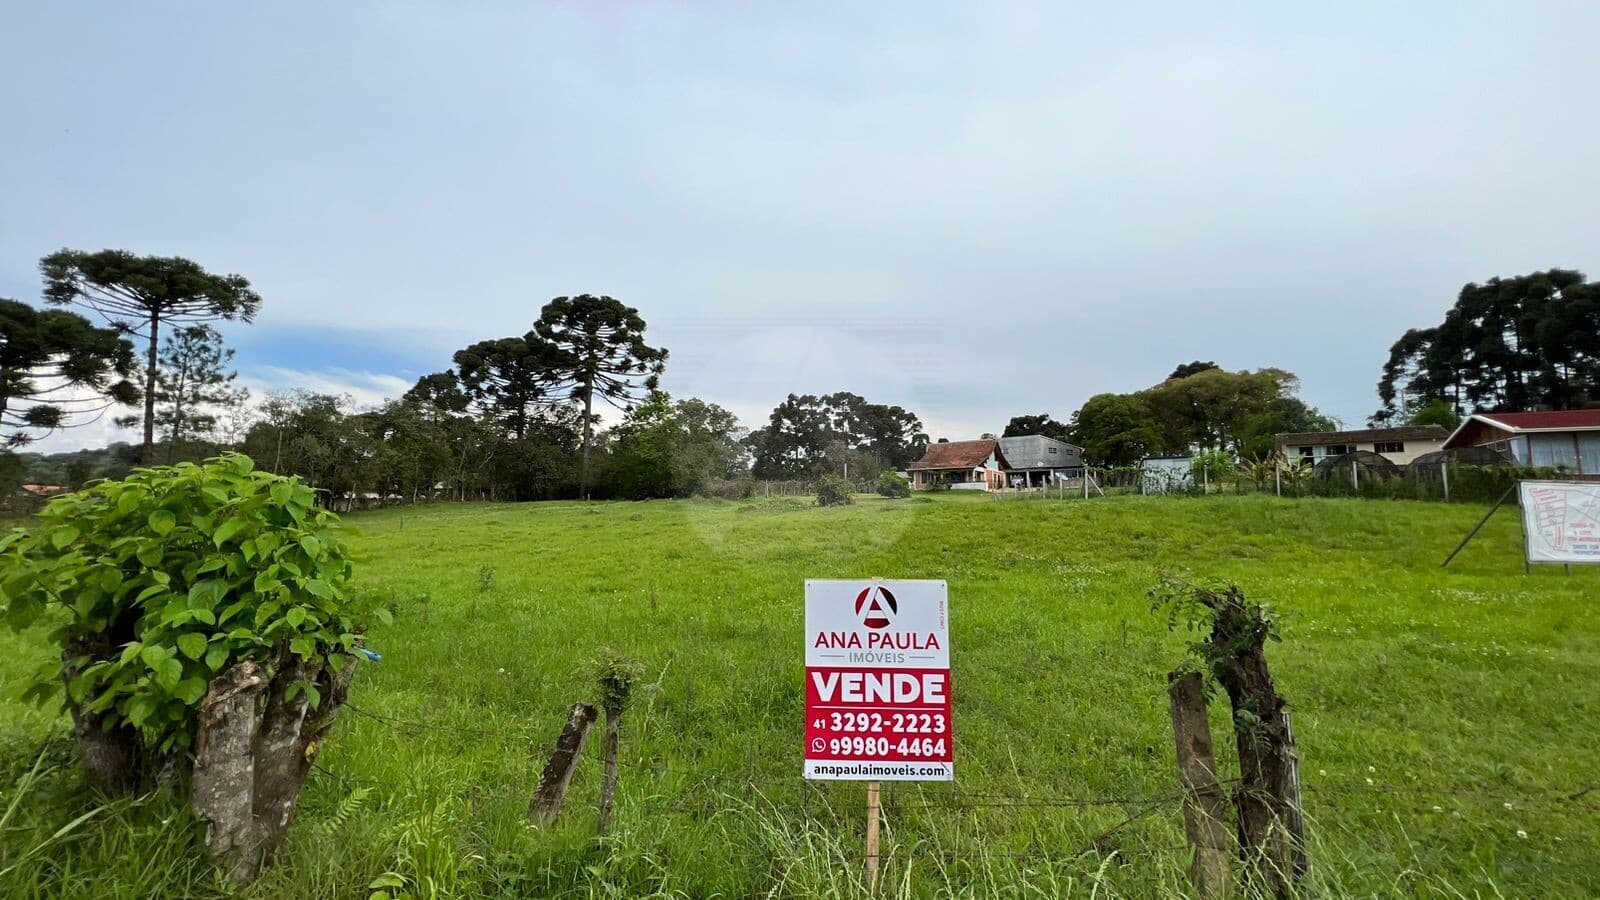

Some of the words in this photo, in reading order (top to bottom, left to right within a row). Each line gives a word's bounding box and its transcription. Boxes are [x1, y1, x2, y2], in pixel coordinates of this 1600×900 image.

[815, 631, 862, 649] ANA
[868, 632, 940, 650] PAULA
[849, 650, 905, 663] IMÓVEIS
[811, 671, 946, 704] VENDE
[813, 719, 826, 729] 41
[830, 712, 946, 733] 3292-2223
[830, 736, 946, 756] 99980-4464
[814, 764, 945, 776] anapaulaimoveis.com
